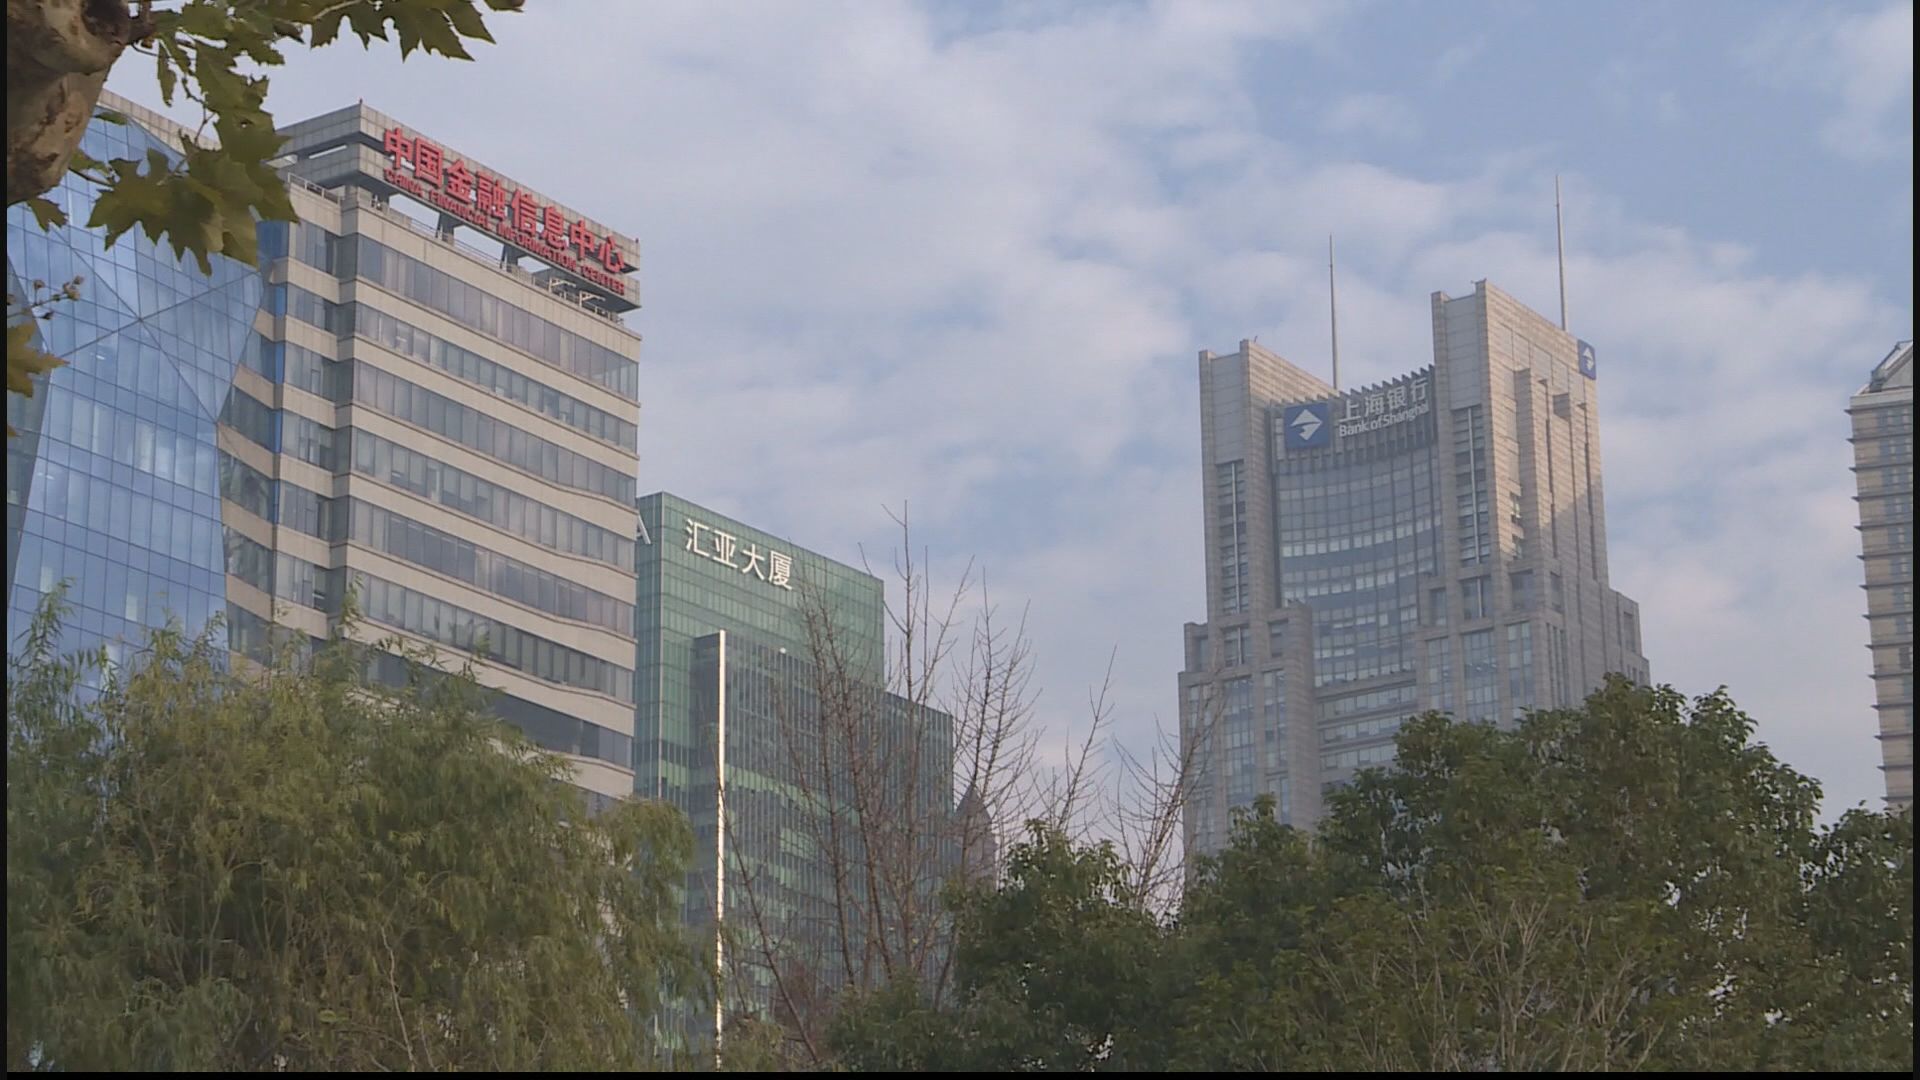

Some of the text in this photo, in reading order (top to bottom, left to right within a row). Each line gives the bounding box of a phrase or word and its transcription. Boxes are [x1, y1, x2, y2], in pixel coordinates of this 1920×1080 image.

[384, 128, 624, 273] 中国金融信息中心
[384, 168, 624, 296] CHINA FINANCIAL INFORMATION CENTER
[1339, 377, 1428, 423] 上海银行
[1340, 420, 1369, 437] Bank
[1382, 401, 1430, 427] Shanghai
[686, 518, 793, 590] 汇亚大厦
